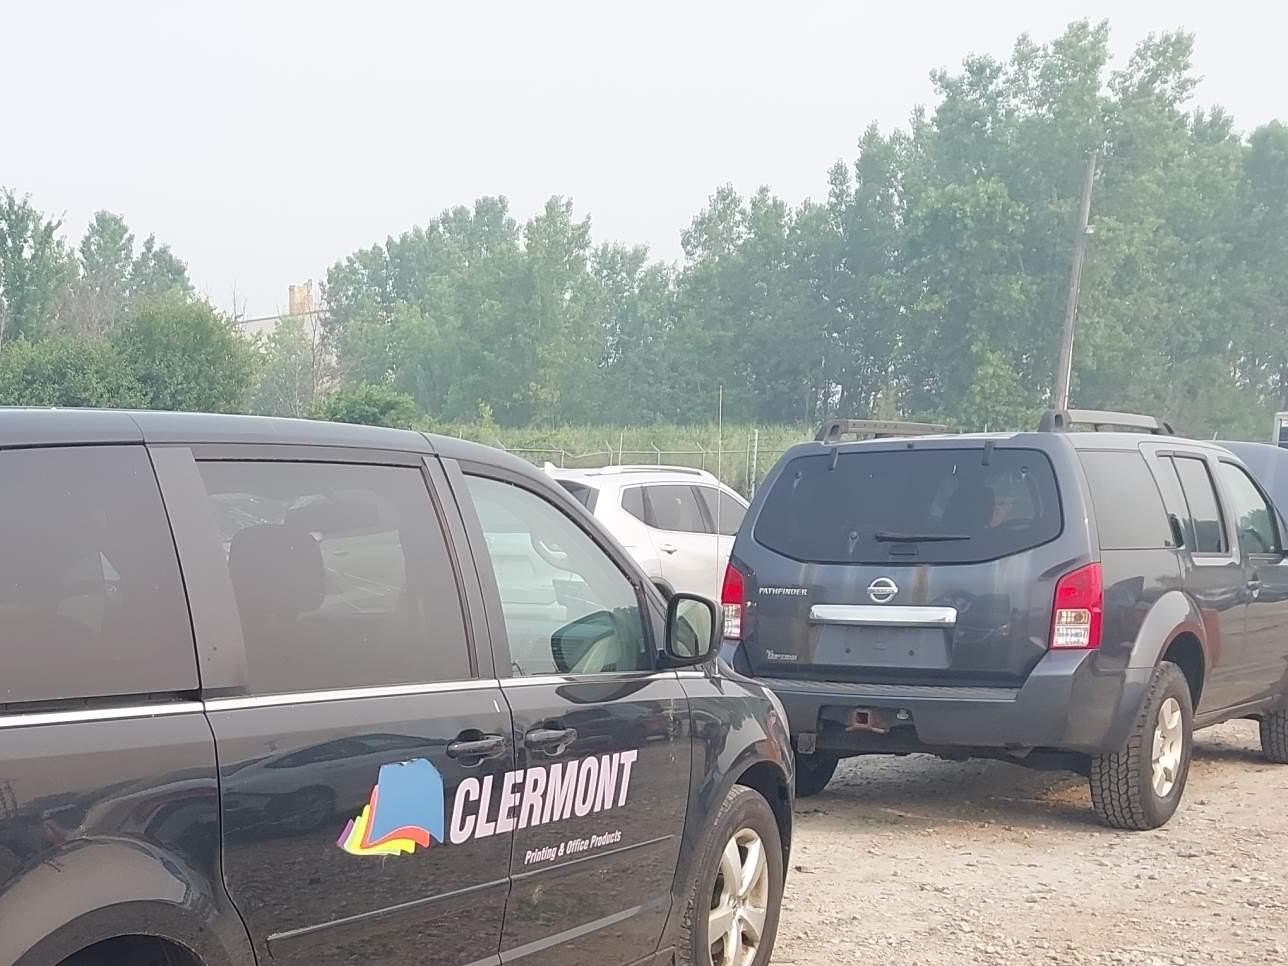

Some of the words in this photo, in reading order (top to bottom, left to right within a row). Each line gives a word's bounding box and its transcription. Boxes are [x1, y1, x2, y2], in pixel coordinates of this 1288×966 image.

[759, 587, 808, 596] PATHFINDER
[450, 749, 639, 845] CLERMONT
[524, 845, 558, 865] Printing
[558, 842, 565, 857] &
[566, 838, 590, 854] Office
[590, 829, 622, 849] Products
